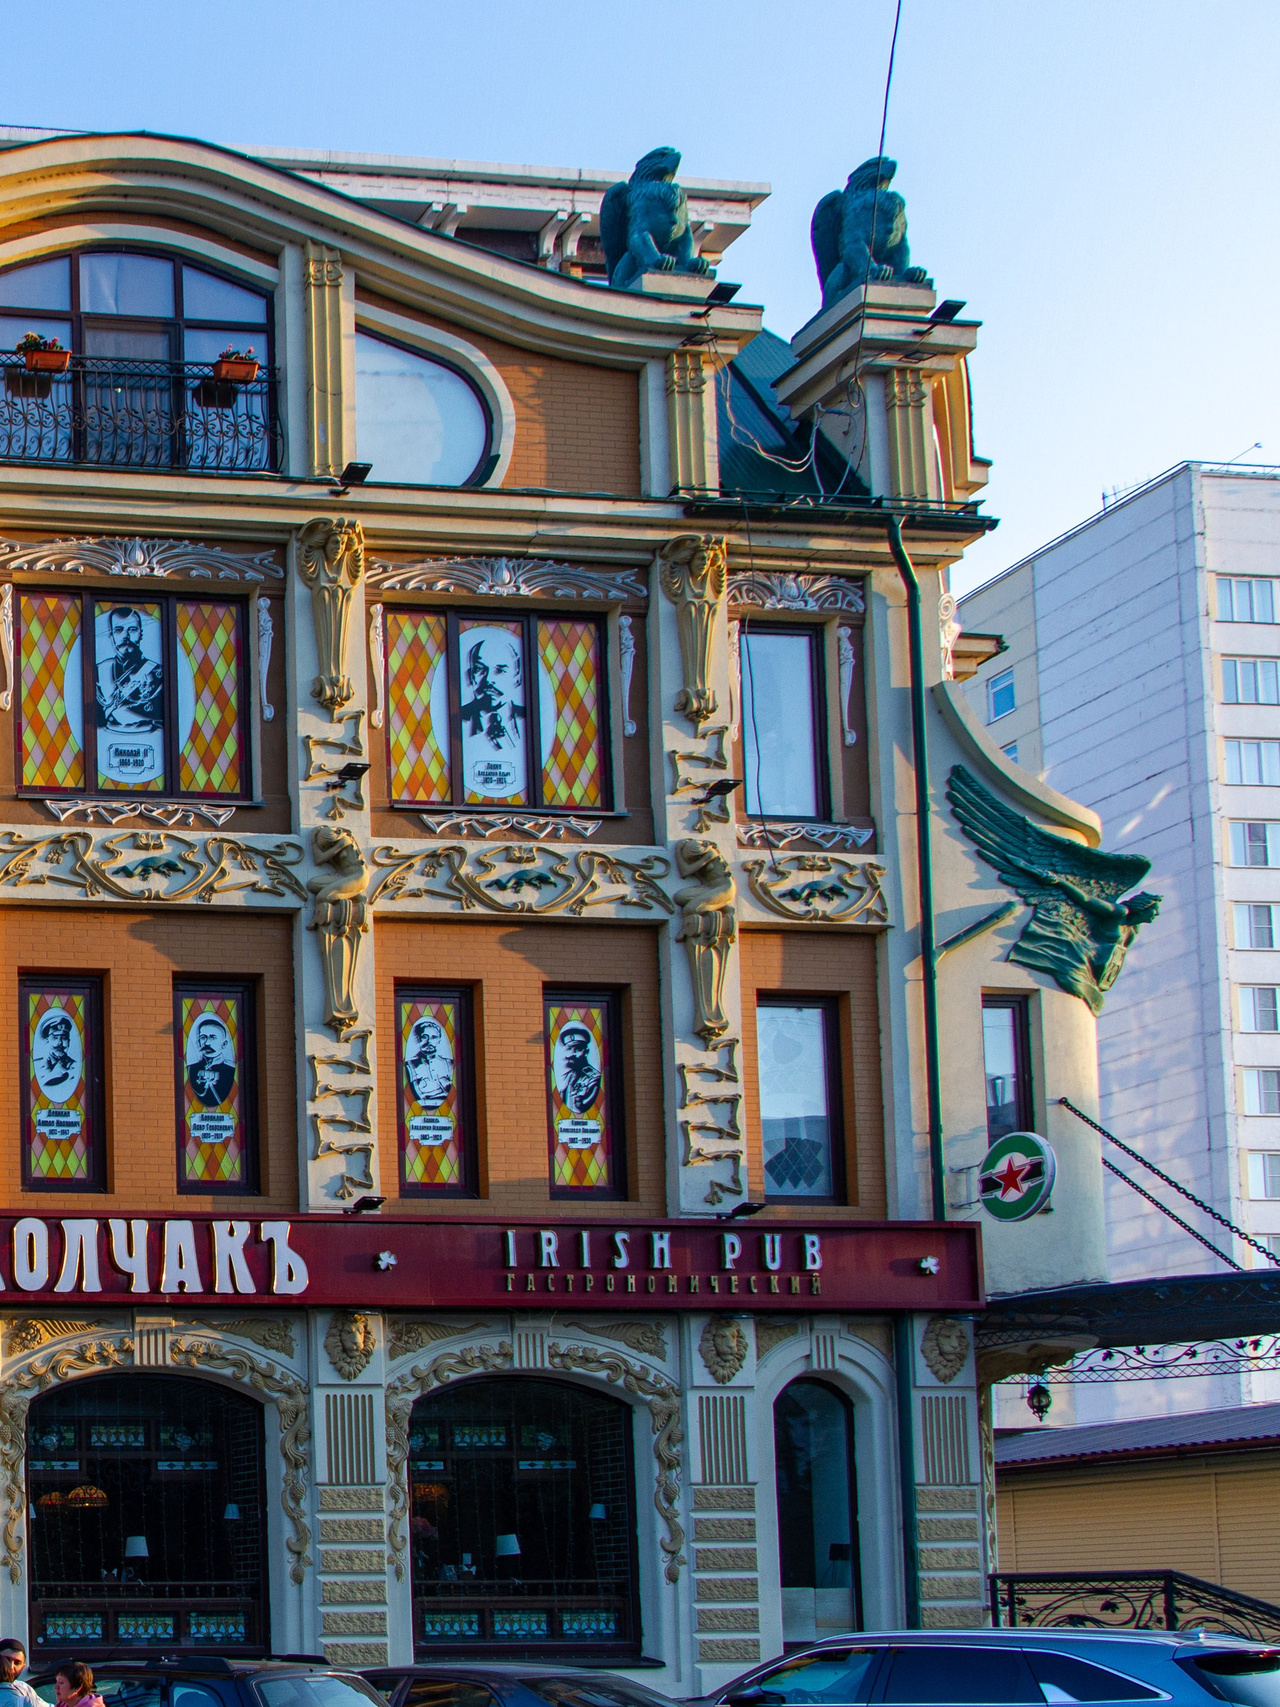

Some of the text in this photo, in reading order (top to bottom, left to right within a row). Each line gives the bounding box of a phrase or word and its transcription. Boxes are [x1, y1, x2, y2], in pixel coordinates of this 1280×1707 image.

[114, 747, 140, 757] Николай
[504, 1229, 823, 1271] IRISH PUB
[505, 1272, 822, 1295] ГАСТРОНОМИЧЕСКИЙ
